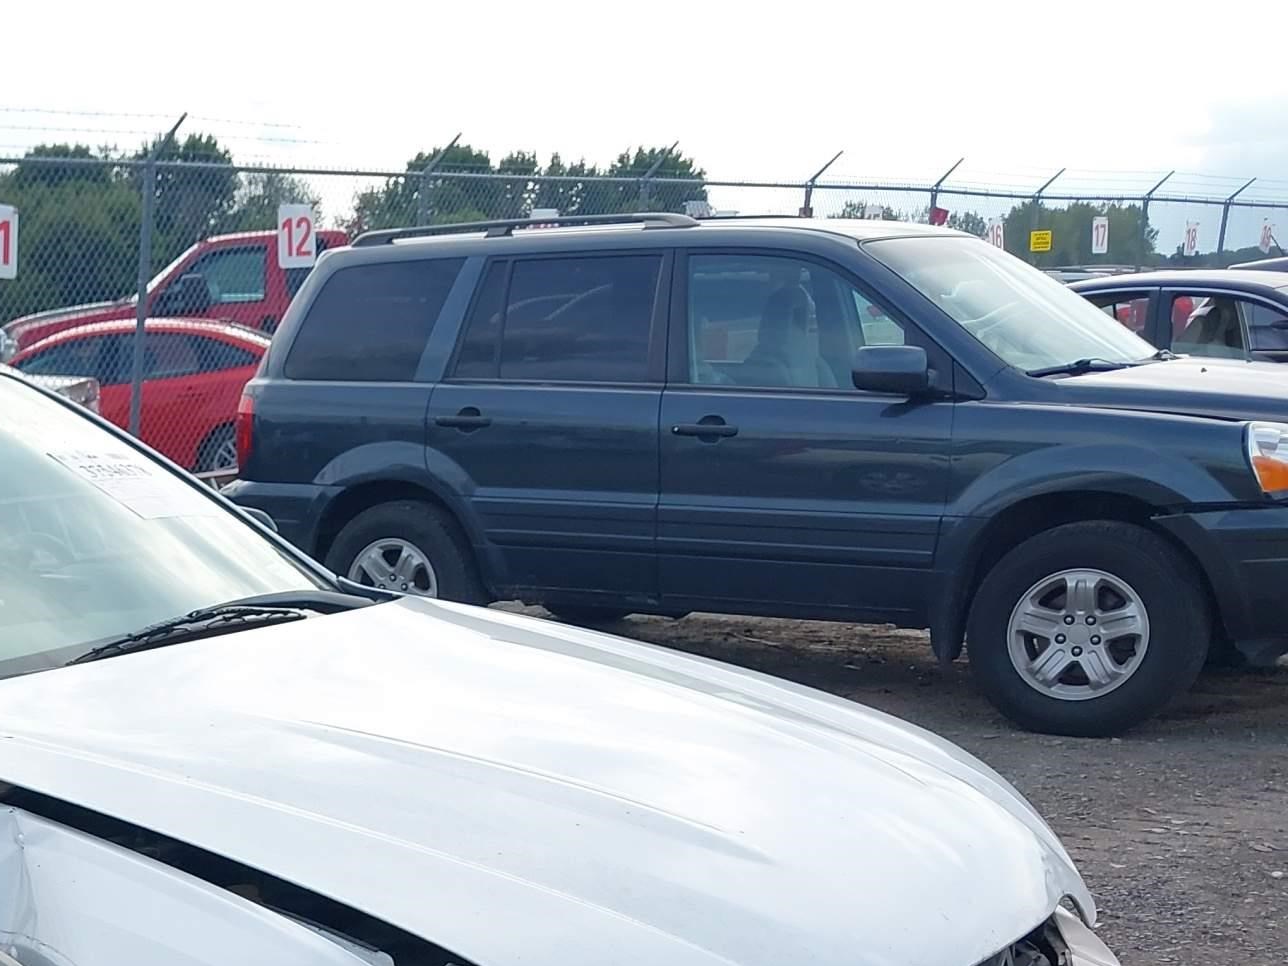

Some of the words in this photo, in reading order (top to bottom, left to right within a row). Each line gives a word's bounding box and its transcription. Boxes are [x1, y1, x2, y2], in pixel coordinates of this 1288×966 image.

[282, 216, 312, 257] 12
[990, 224, 1002, 249] 16
[1094, 223, 1106, 247] 17
[1187, 228, 1197, 251] 18
